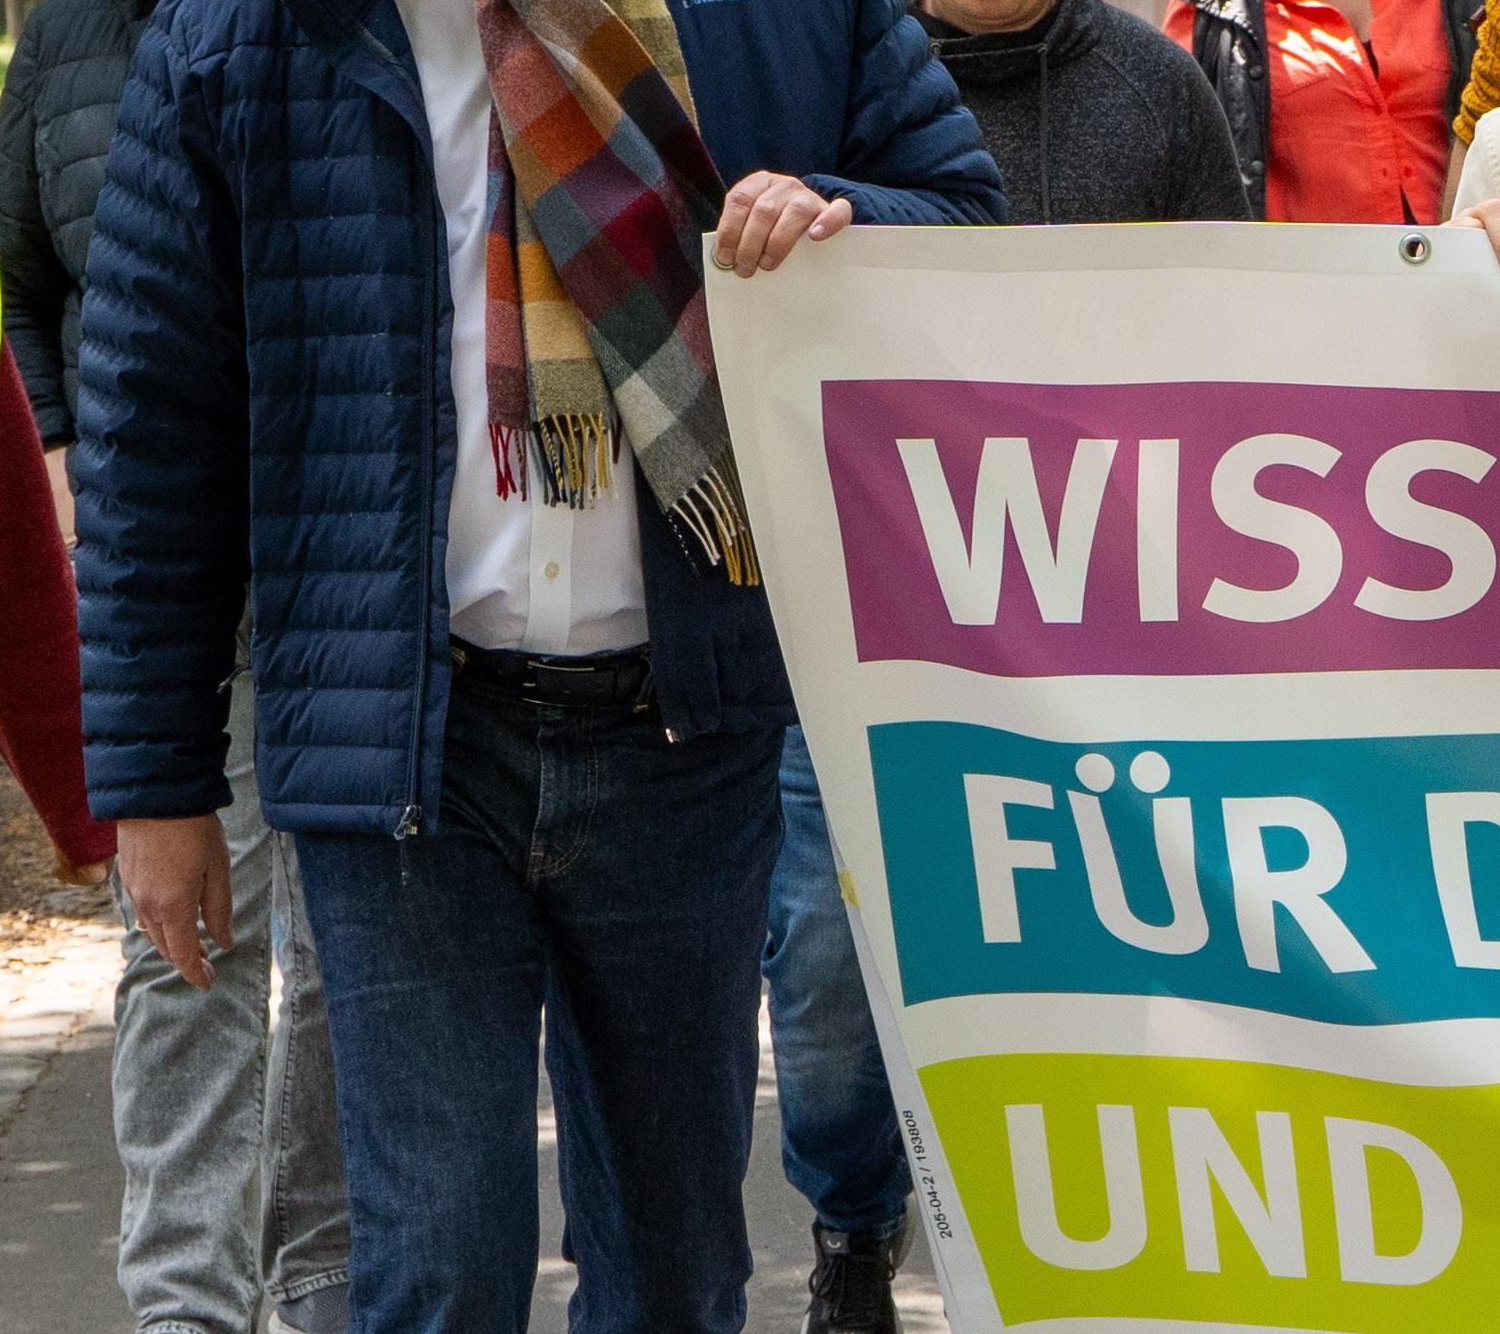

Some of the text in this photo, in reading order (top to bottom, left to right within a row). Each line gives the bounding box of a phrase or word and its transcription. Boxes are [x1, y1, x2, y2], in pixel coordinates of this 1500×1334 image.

[964, 750, 1375, 975] FÜR
[902, 1109, 927, 1163] 193808
[1007, 1104, 1461, 1286] UND
[921, 1175, 953, 1239] 205-04-2
